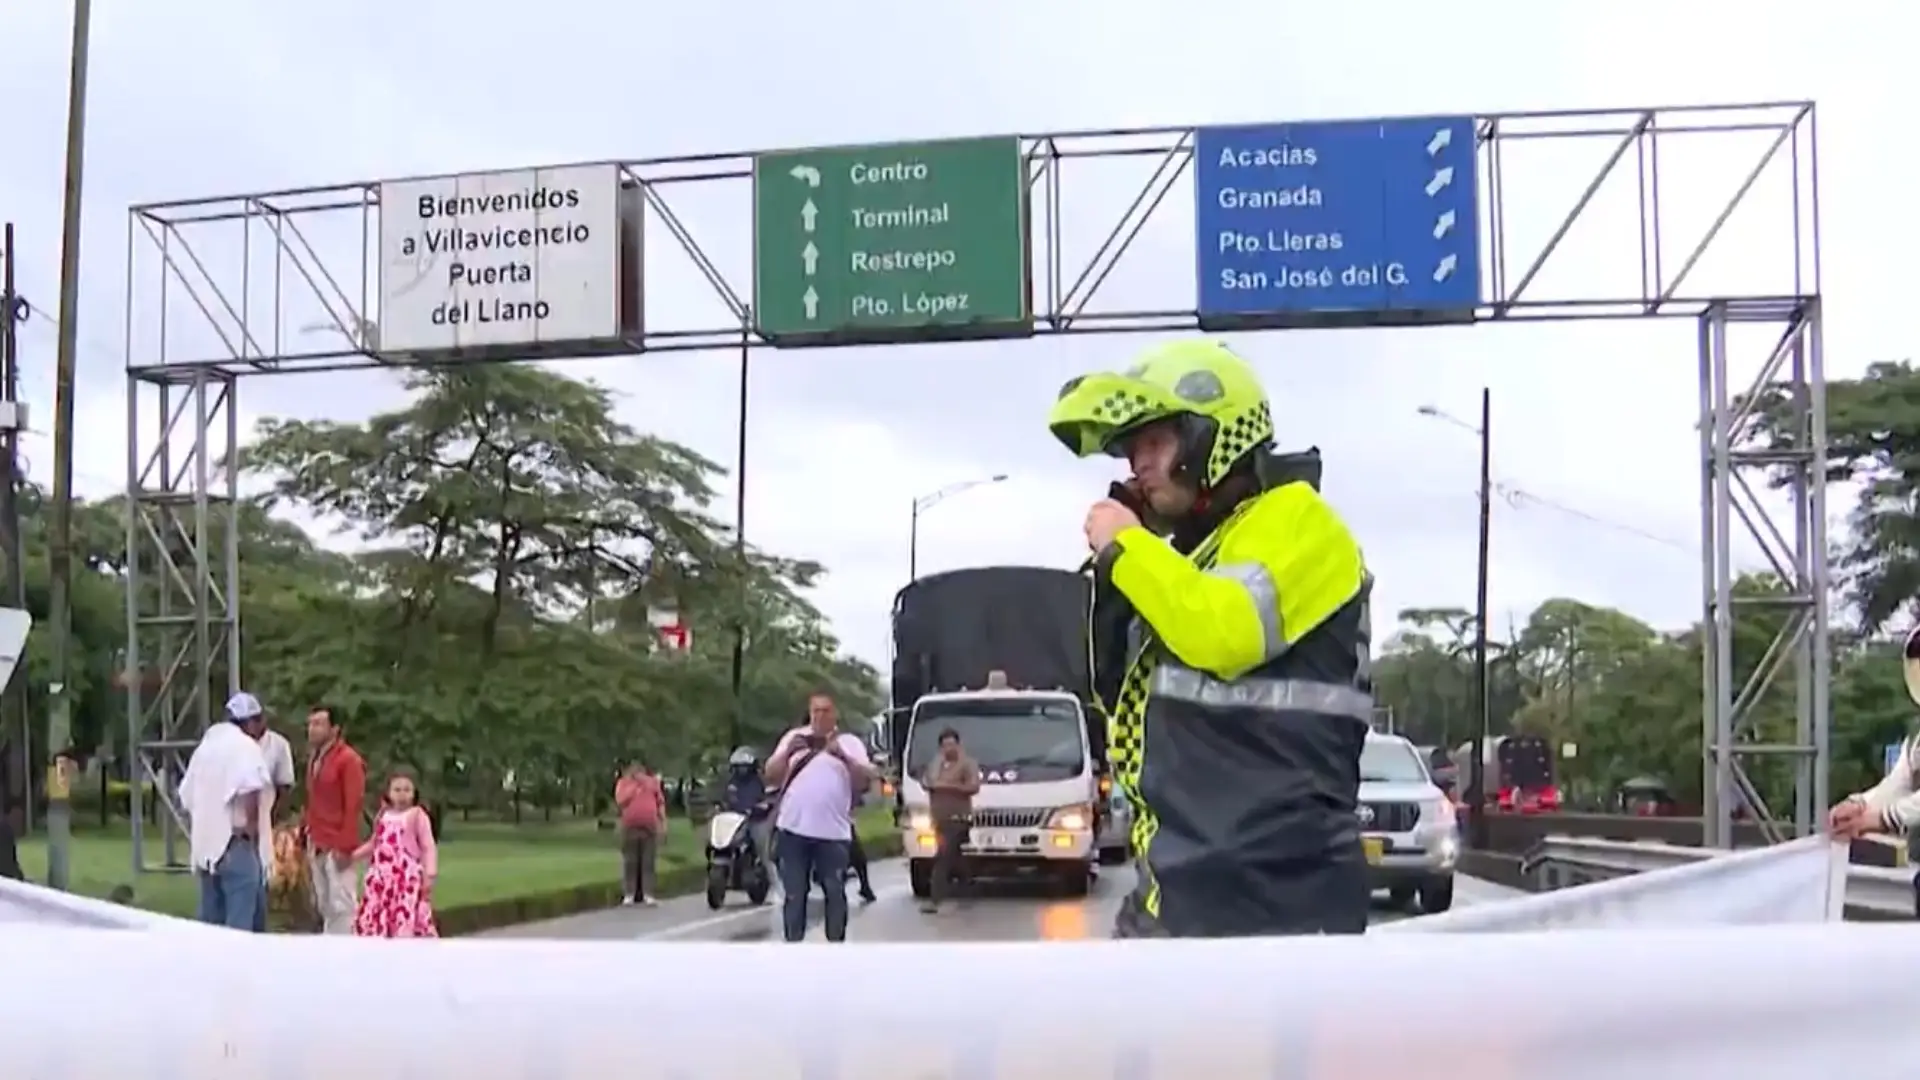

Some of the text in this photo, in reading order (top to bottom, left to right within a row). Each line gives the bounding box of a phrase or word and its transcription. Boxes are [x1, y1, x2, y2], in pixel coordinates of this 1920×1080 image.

[850, 162, 928, 184] Centro
[418, 188, 579, 218] Bienvenidos
[1218, 185, 1322, 208] Granada
[851, 203, 949, 228] Terminal
[402, 221, 590, 255] a Villavicencio
[1268, 230, 1344, 251] Lleras
[852, 249, 956, 272] Restrepo
[449, 262, 532, 286] Puerta
[1221, 262, 1410, 289] San José del G.
[432, 298, 551, 324] del Llano
[852, 291, 969, 317] Pto. López
